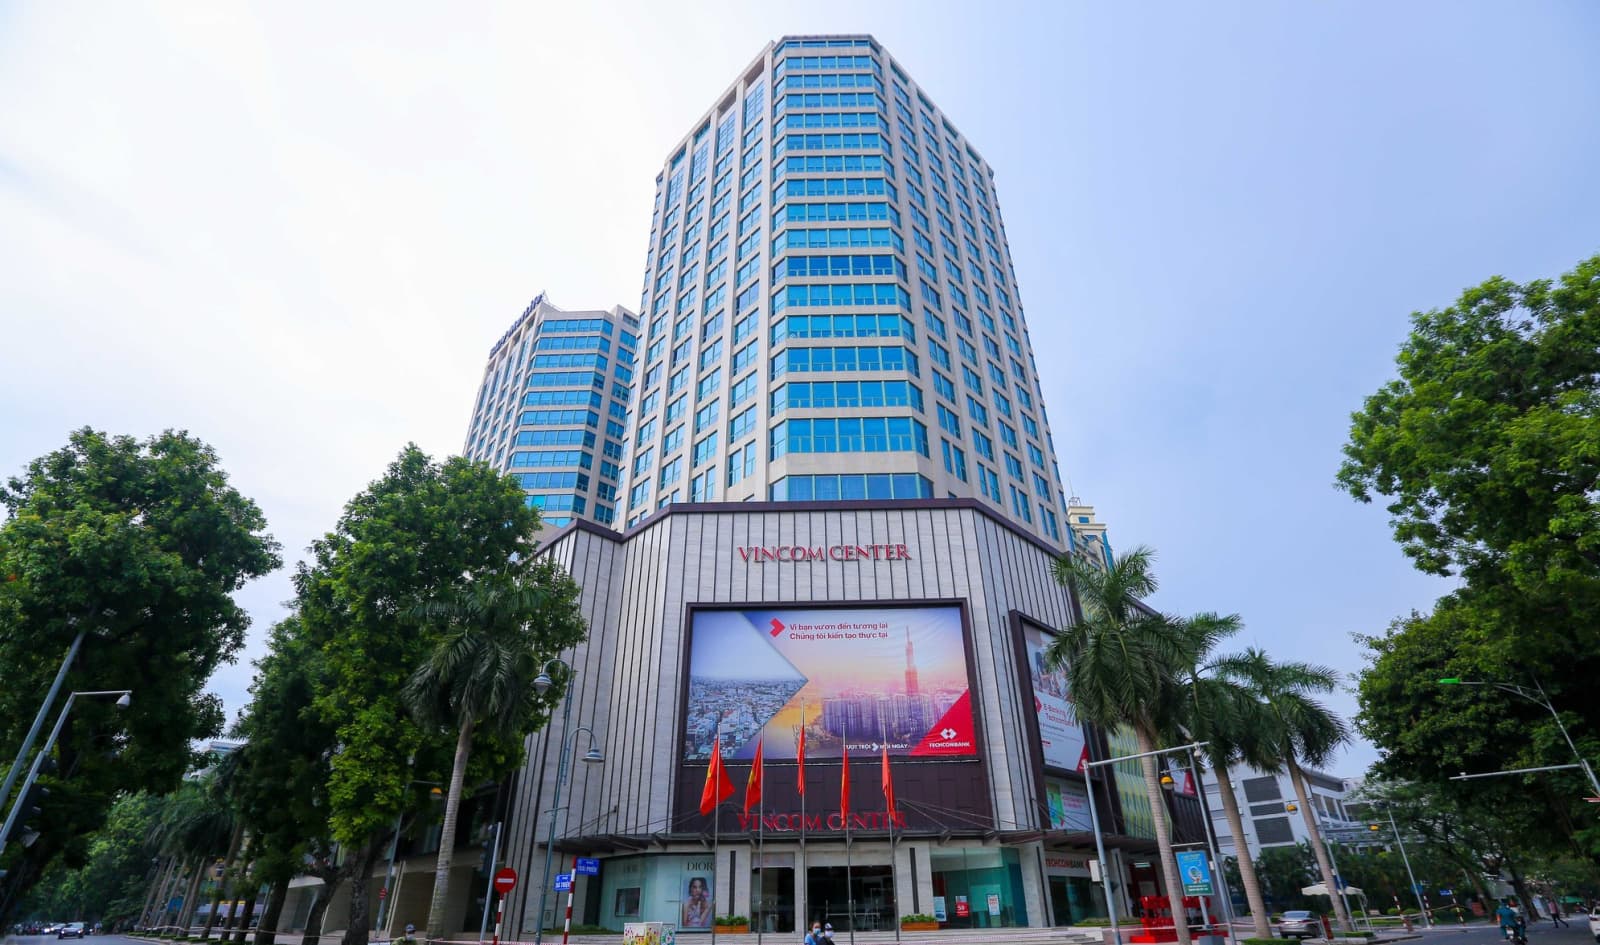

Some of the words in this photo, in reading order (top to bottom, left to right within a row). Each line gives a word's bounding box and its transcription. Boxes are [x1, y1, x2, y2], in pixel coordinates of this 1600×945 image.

[738, 545, 825, 562] VINCOM
[829, 543, 912, 561] CENTER
[929, 741, 970, 749] TECHCOMBANK
[736, 812, 822, 832] VINCOM
[687, 860, 713, 872] DIOR
